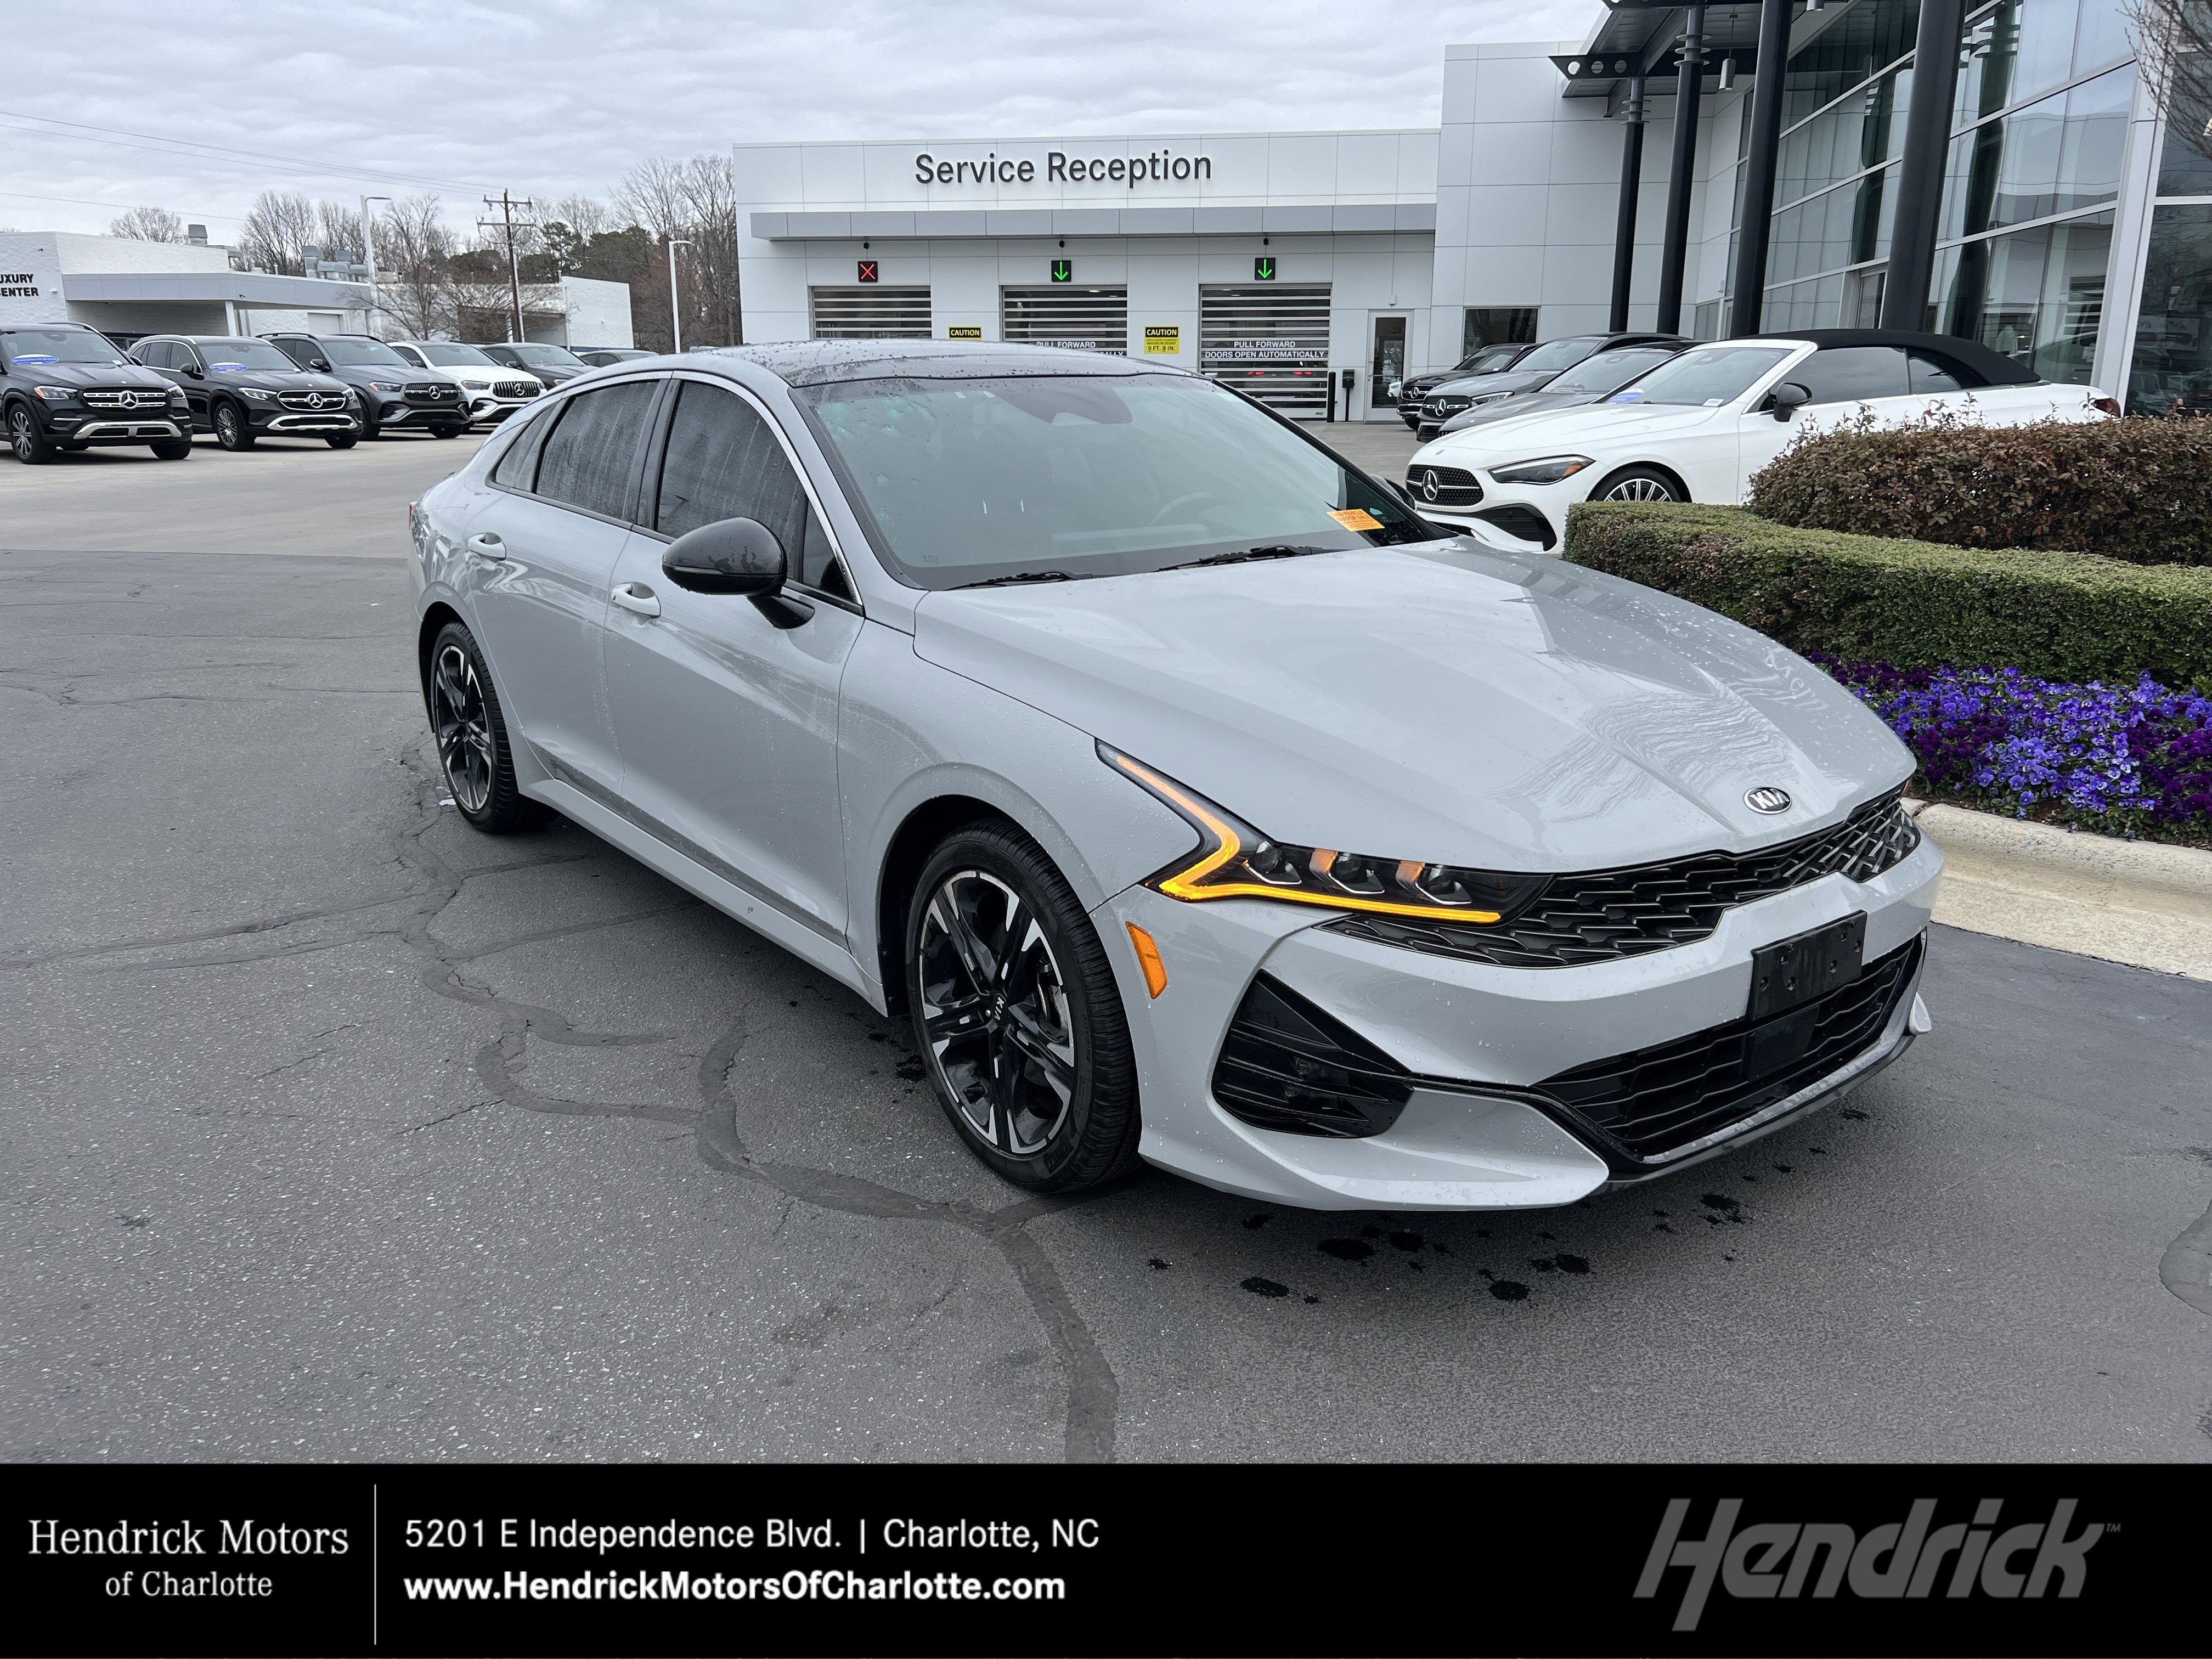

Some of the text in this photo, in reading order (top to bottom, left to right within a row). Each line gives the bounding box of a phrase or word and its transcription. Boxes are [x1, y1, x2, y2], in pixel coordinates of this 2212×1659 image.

[916, 149, 1211, 189] Service Reception
[0, 287, 38, 297] ENTER
[995, 996, 1005, 1020] KIA
